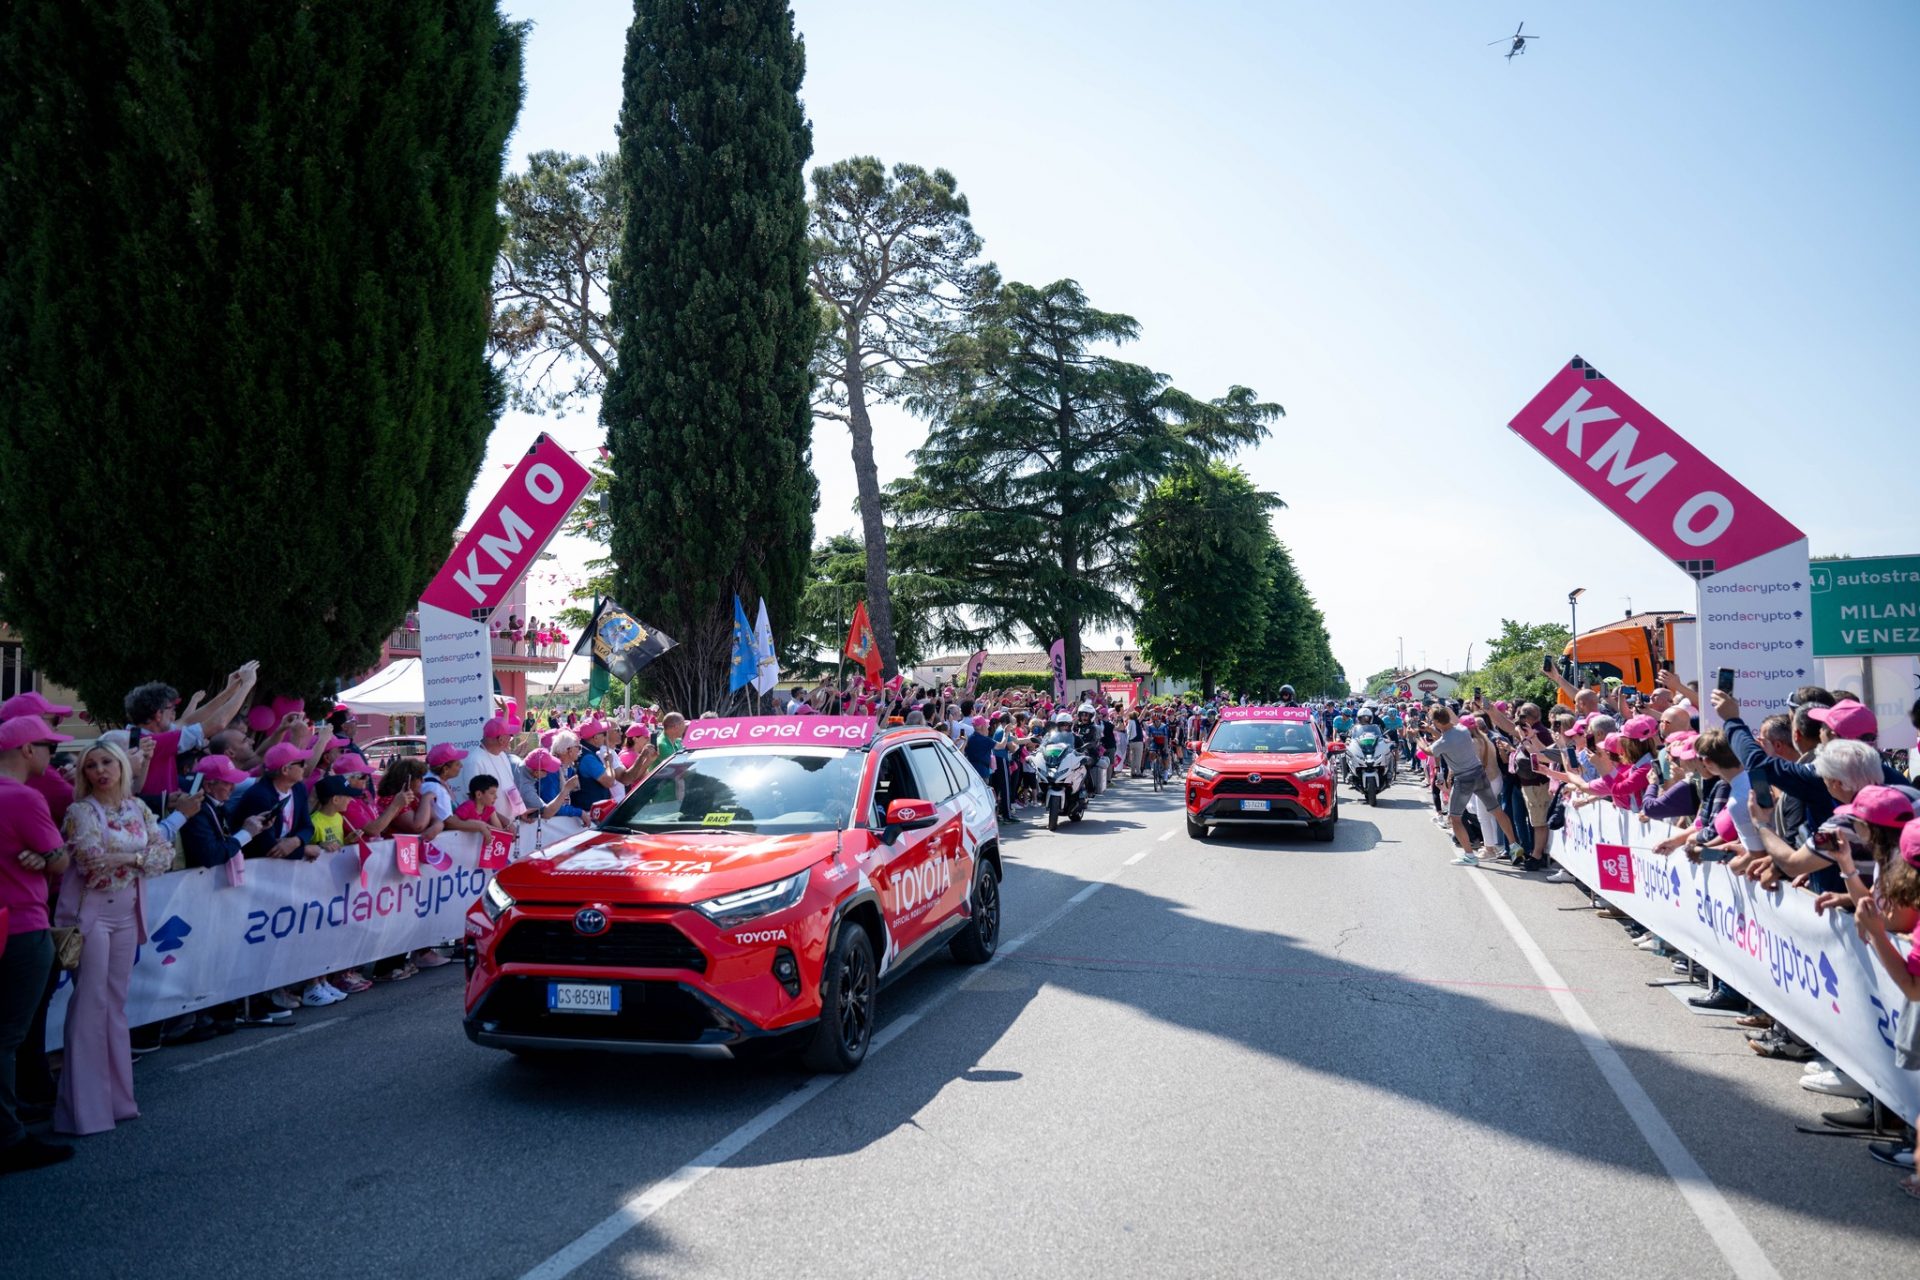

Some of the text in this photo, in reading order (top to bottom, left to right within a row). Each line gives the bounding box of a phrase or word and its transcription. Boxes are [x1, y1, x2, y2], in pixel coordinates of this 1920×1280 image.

[1541, 386, 1679, 504] KM
[452, 504, 535, 605] KM
[1706, 581, 1791, 594] zondacrypto
[1708, 610, 1792, 623] zondacrypto
[1841, 603, 1920, 620] MILAN
[424, 631, 473, 642] zondacrypto
[1709, 639, 1793, 651] zondacrypto
[426, 653, 475, 664] zondacrypto
[427, 675, 476, 686] zondacrypto
[1710, 668, 1794, 681] zdacrypto
[428, 696, 477, 707] zondacrypto
[1224, 708, 1308, 718] enel enel enel
[429, 718, 479, 729] zondacrypto
[689, 721, 868, 741] enel enel enel
[706, 815, 731, 824] RACE
[556, 860, 713, 873] TOYOTA
[891, 855, 951, 916] TOYOTA
[244, 865, 486, 945] zondacrypto
[735, 929, 787, 944] TOYOTA
[1695, 888, 1820, 1000] zondacrypto
